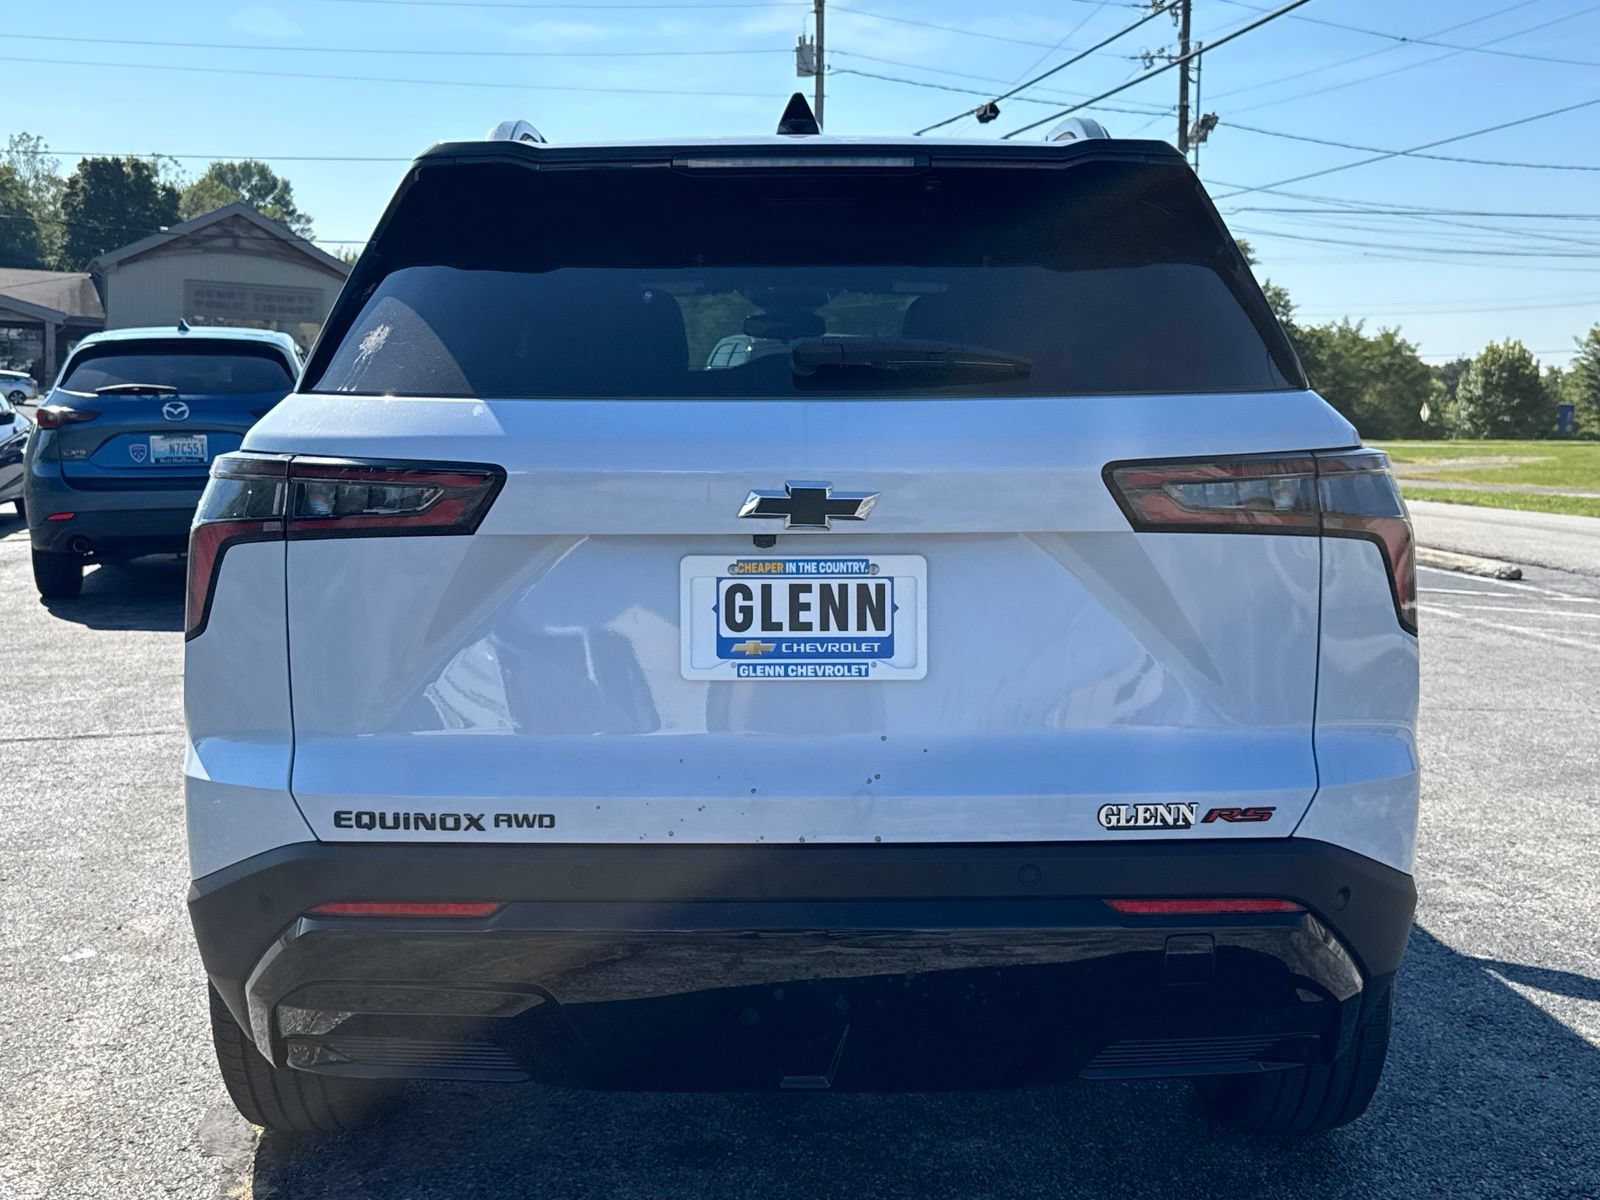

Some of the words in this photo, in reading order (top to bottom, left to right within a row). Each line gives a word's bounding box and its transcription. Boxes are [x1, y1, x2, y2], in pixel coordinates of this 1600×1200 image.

[737, 562, 784, 574] CHEAPER
[785, 562, 797, 573] IN
[798, 562, 818, 573] THE
[818, 562, 869, 573] COUNTRY.
[724, 583, 886, 633] GLENN
[781, 642, 881, 653] CHEVROLET
[738, 664, 785, 677] GLENN
[787, 664, 868, 677] CHEVROLET
[333, 810, 486, 832] EQUINOX
[493, 813, 556, 828] AWD
[1097, 802, 1200, 831] GLENN
[1200, 806, 1277, 824] RS
